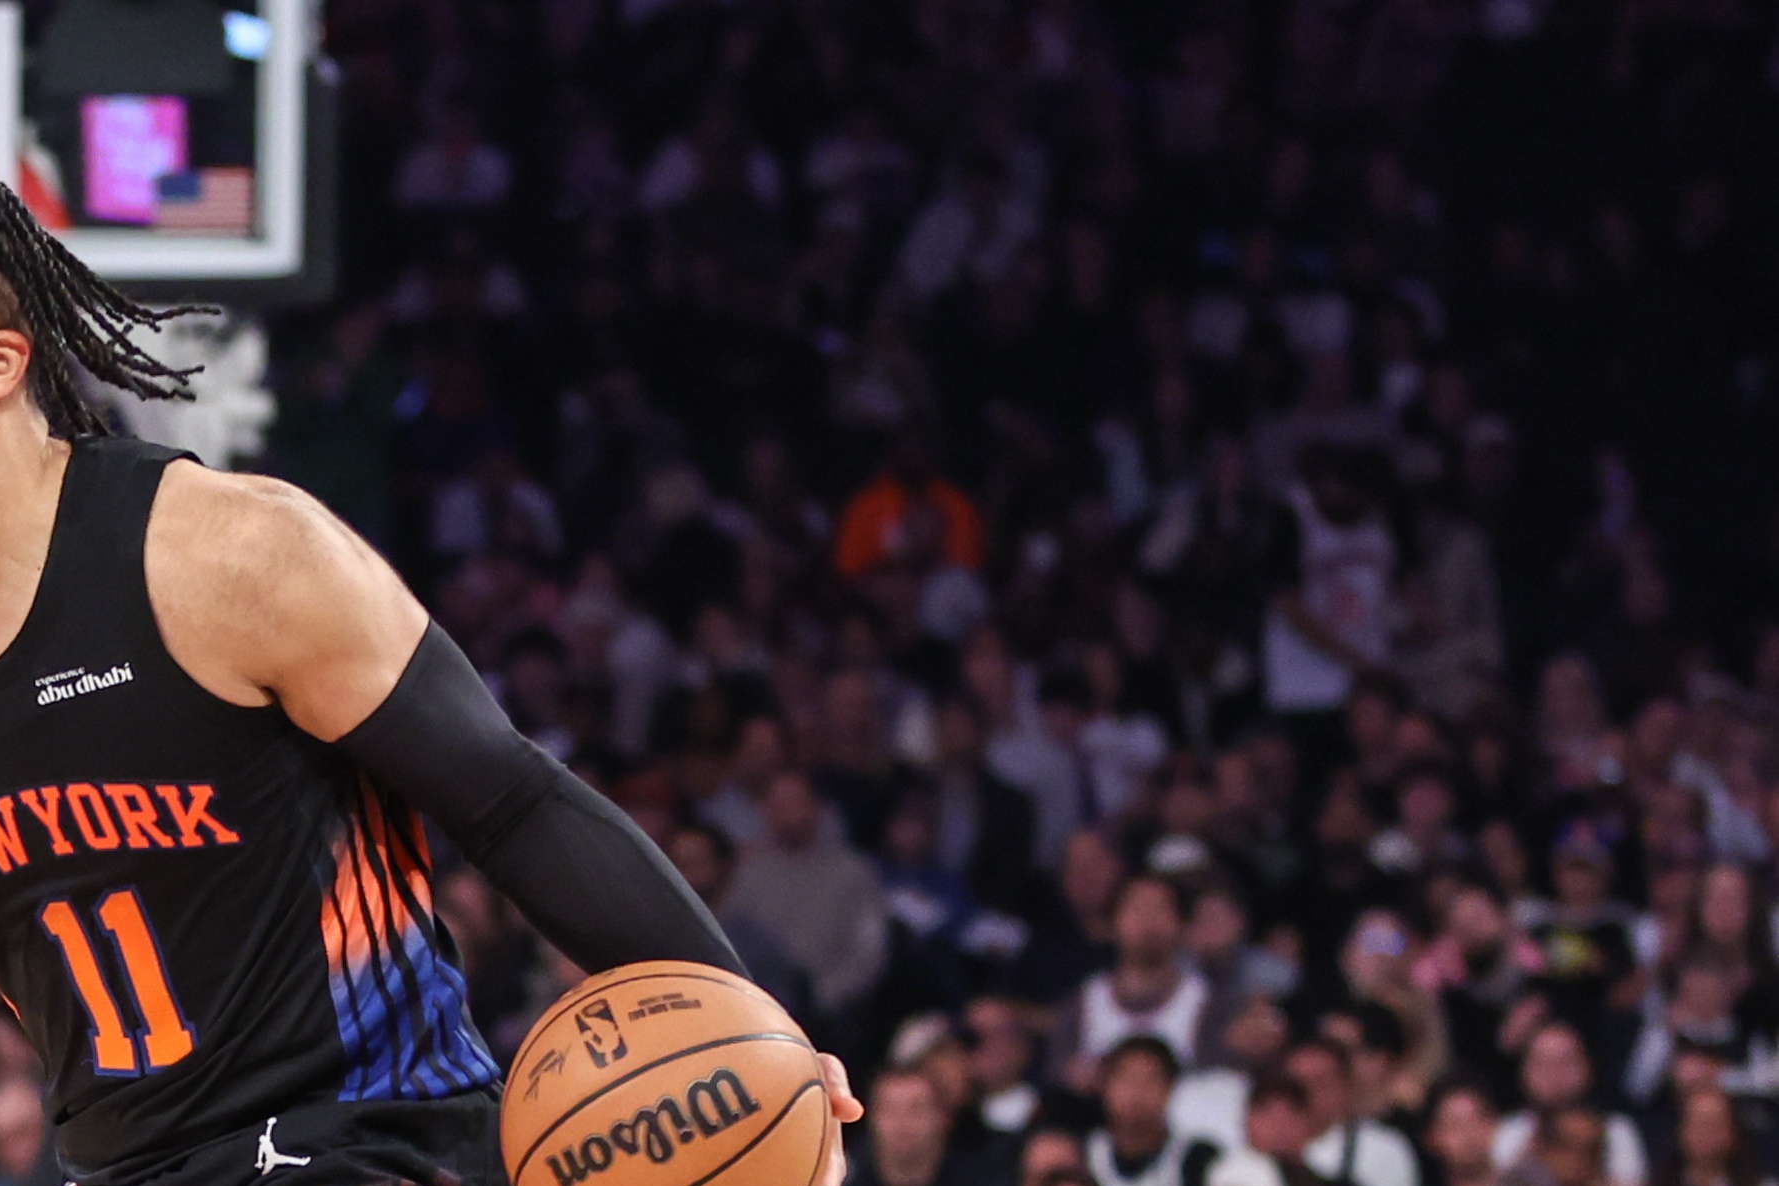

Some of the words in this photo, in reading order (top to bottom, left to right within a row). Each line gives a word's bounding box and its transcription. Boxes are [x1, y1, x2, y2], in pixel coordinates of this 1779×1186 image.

[37, 685, 75, 705] abu
[75, 662, 133, 694] dhabi
[18, 783, 239, 856] YORK
[36, 889, 196, 1077] 11
